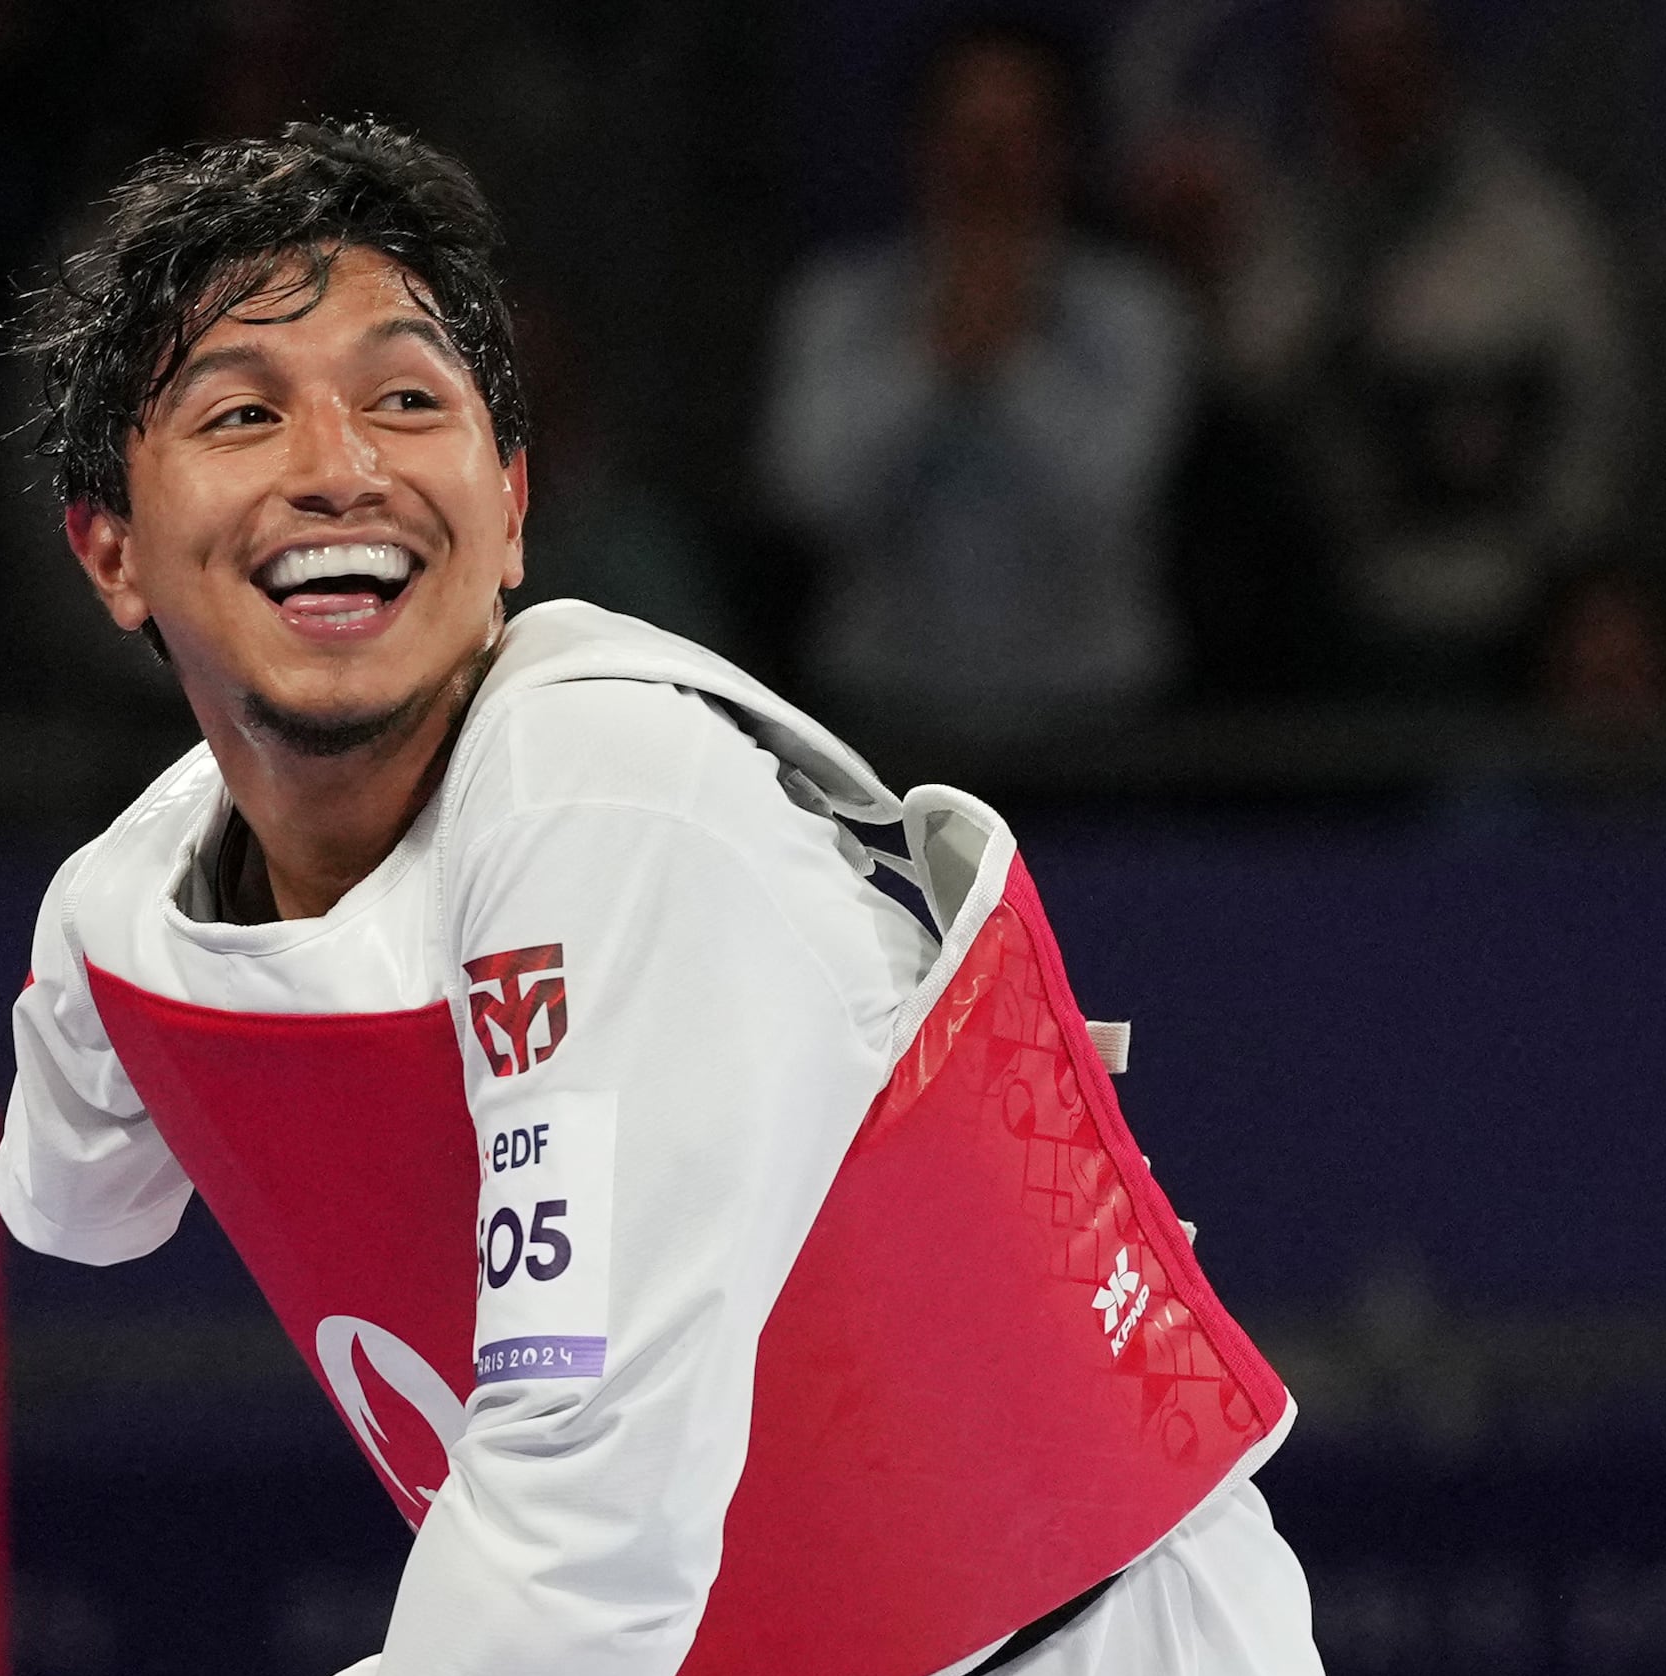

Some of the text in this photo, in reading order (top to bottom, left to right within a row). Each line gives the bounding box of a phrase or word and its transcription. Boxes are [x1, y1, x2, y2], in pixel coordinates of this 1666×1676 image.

[478, 1199, 572, 1297] 05
[508, 1346, 573, 1369] 2024
[1110, 1283, 1151, 1358] KPNP
